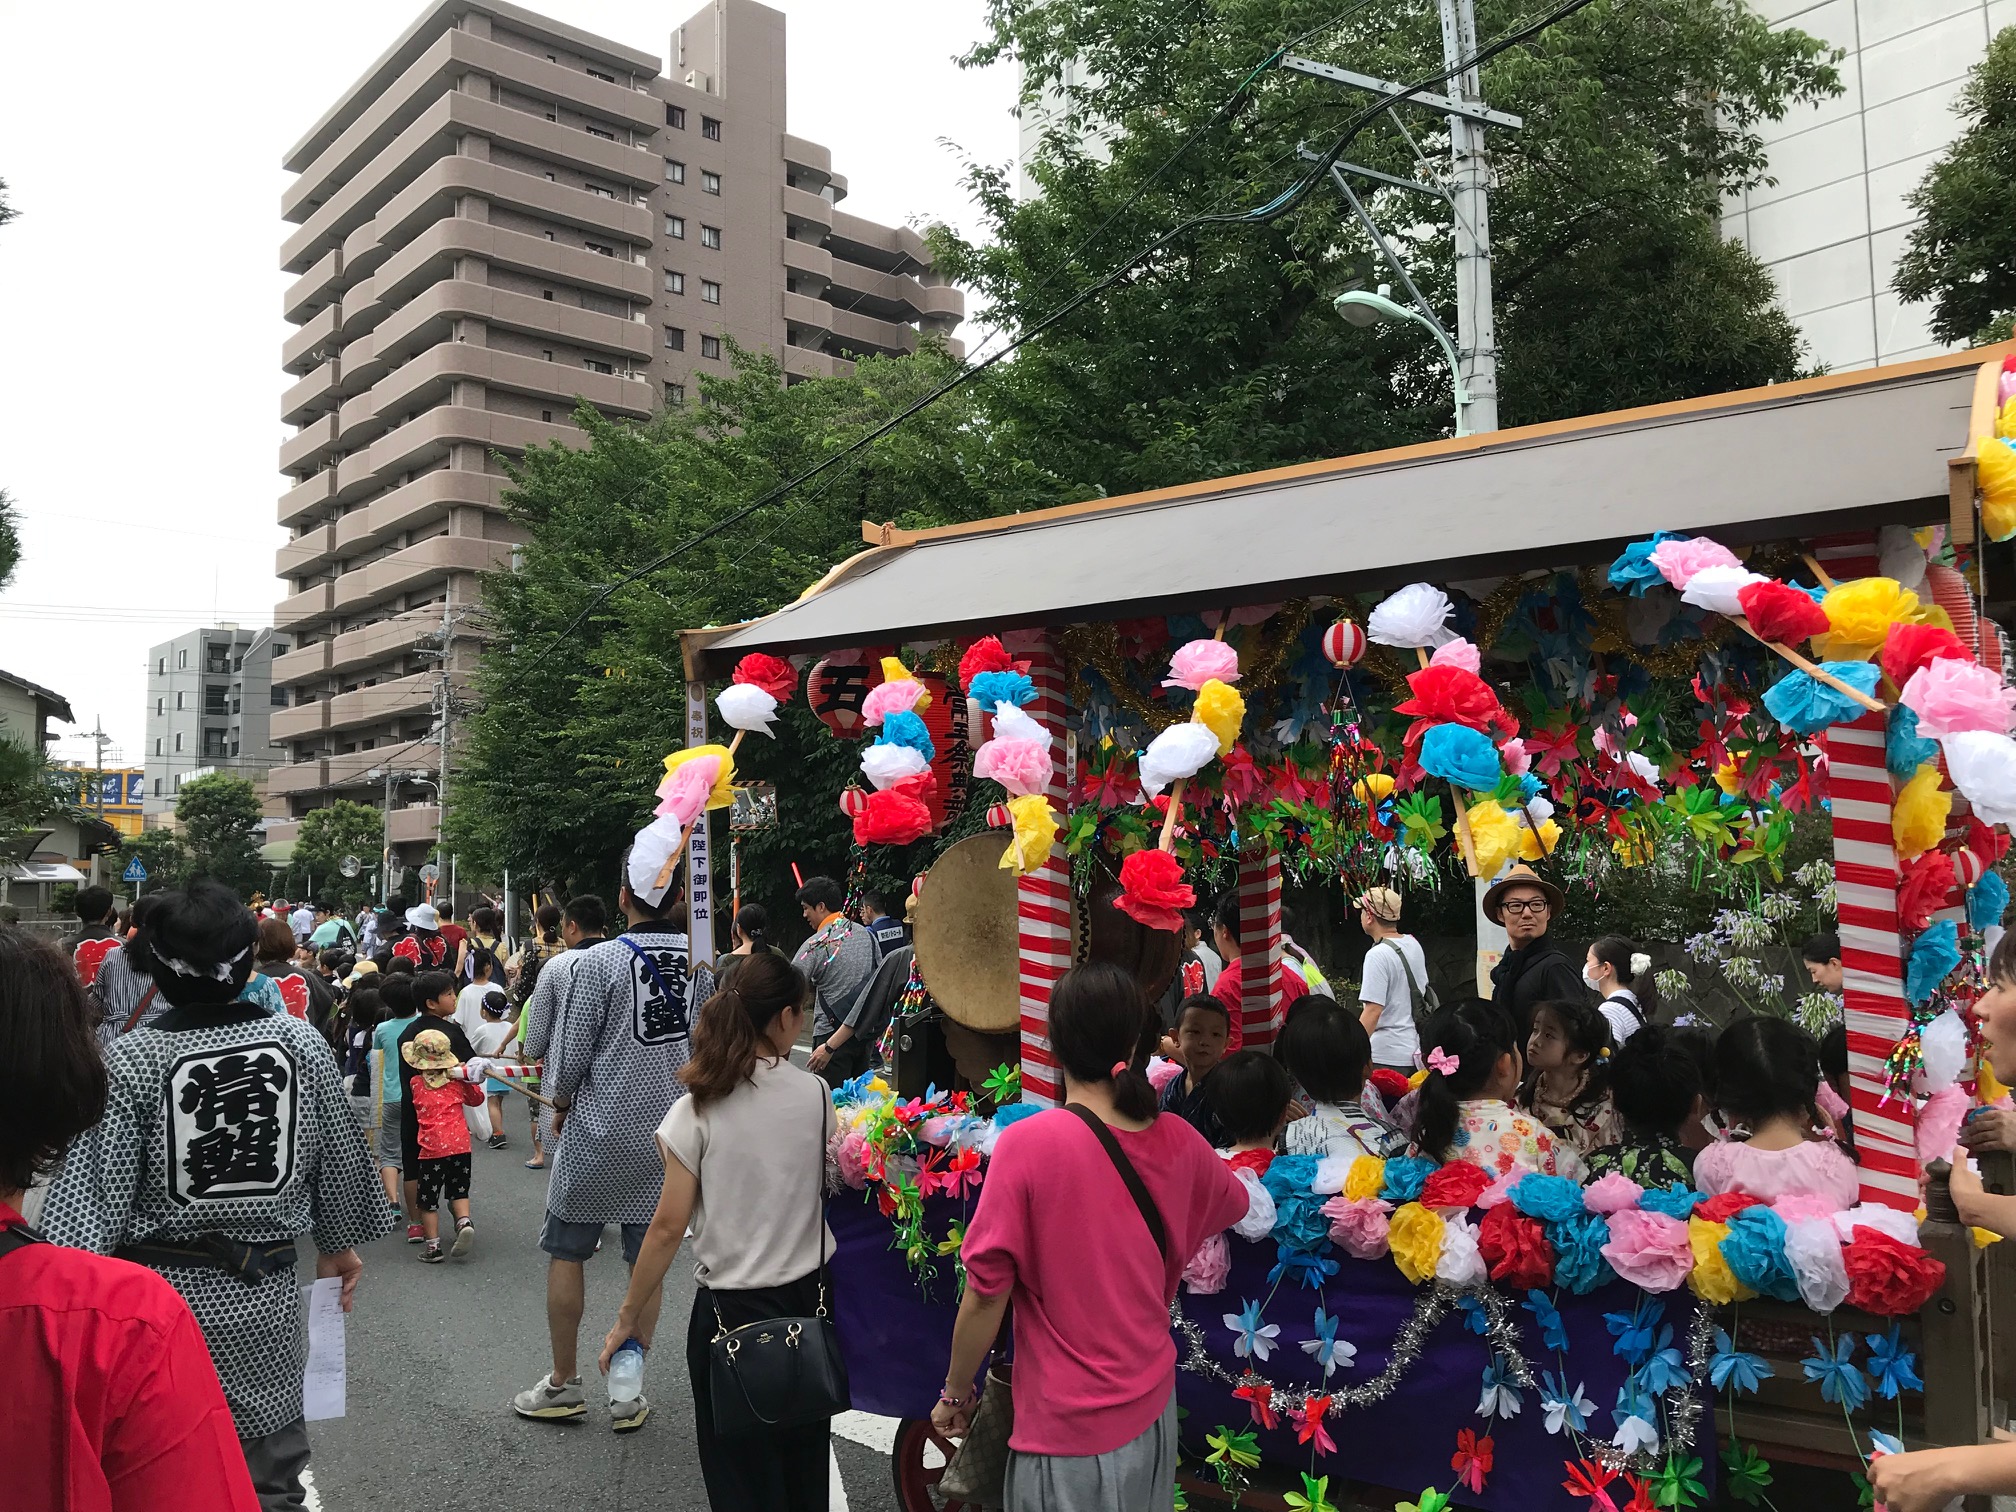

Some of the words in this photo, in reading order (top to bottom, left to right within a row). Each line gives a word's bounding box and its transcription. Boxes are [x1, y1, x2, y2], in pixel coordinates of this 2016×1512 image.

[690, 710, 704, 739] 奉祝
[691, 811, 709, 920] 皇陛下御即位
[180, 1053, 287, 1195] 常盤
